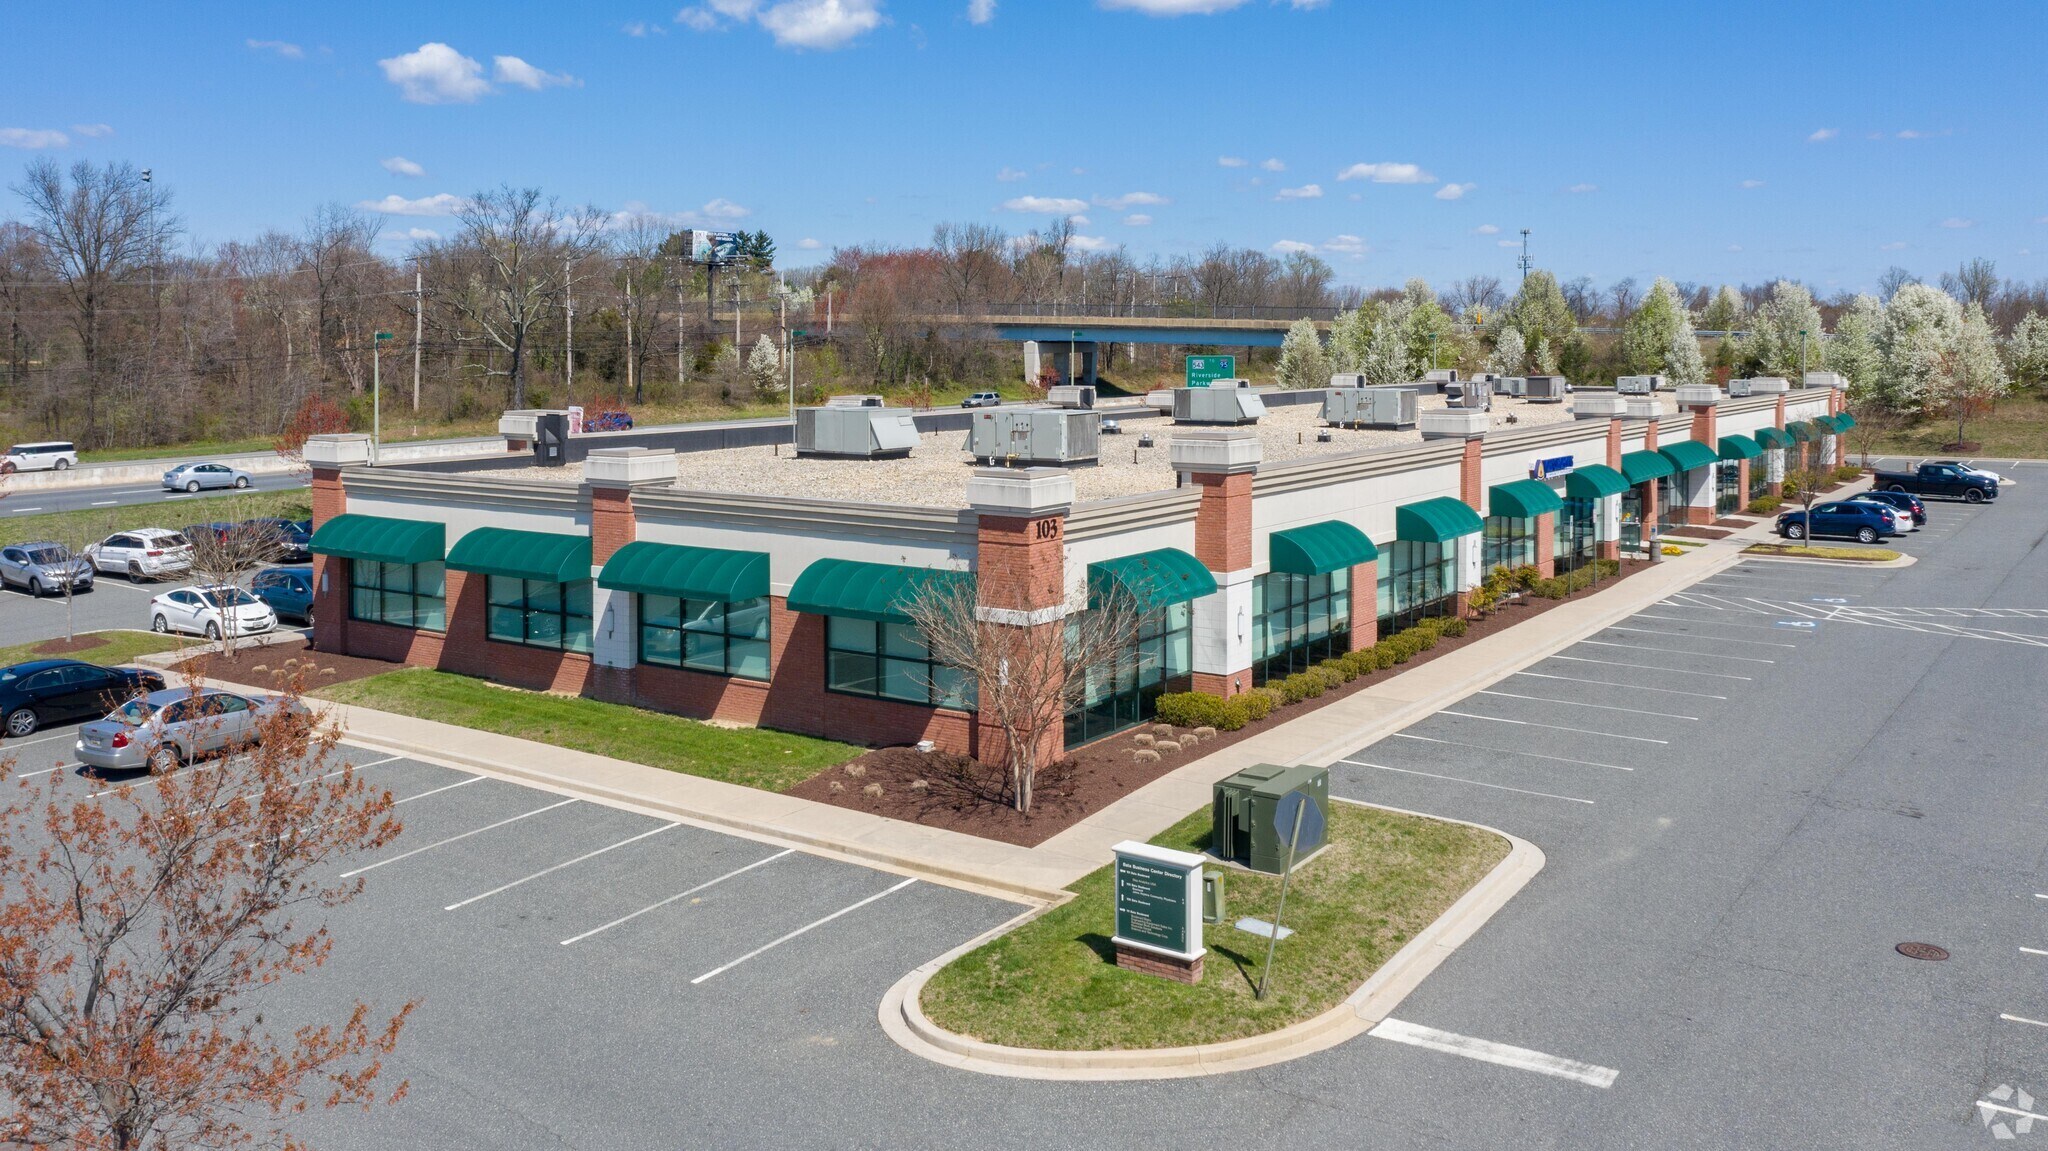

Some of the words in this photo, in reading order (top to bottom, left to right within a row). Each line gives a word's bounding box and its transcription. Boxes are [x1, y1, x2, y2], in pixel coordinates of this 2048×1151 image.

[1036, 519, 1058, 539] 103
[1132, 864, 1150, 872] Business
[1164, 871, 1182, 880] Directory
